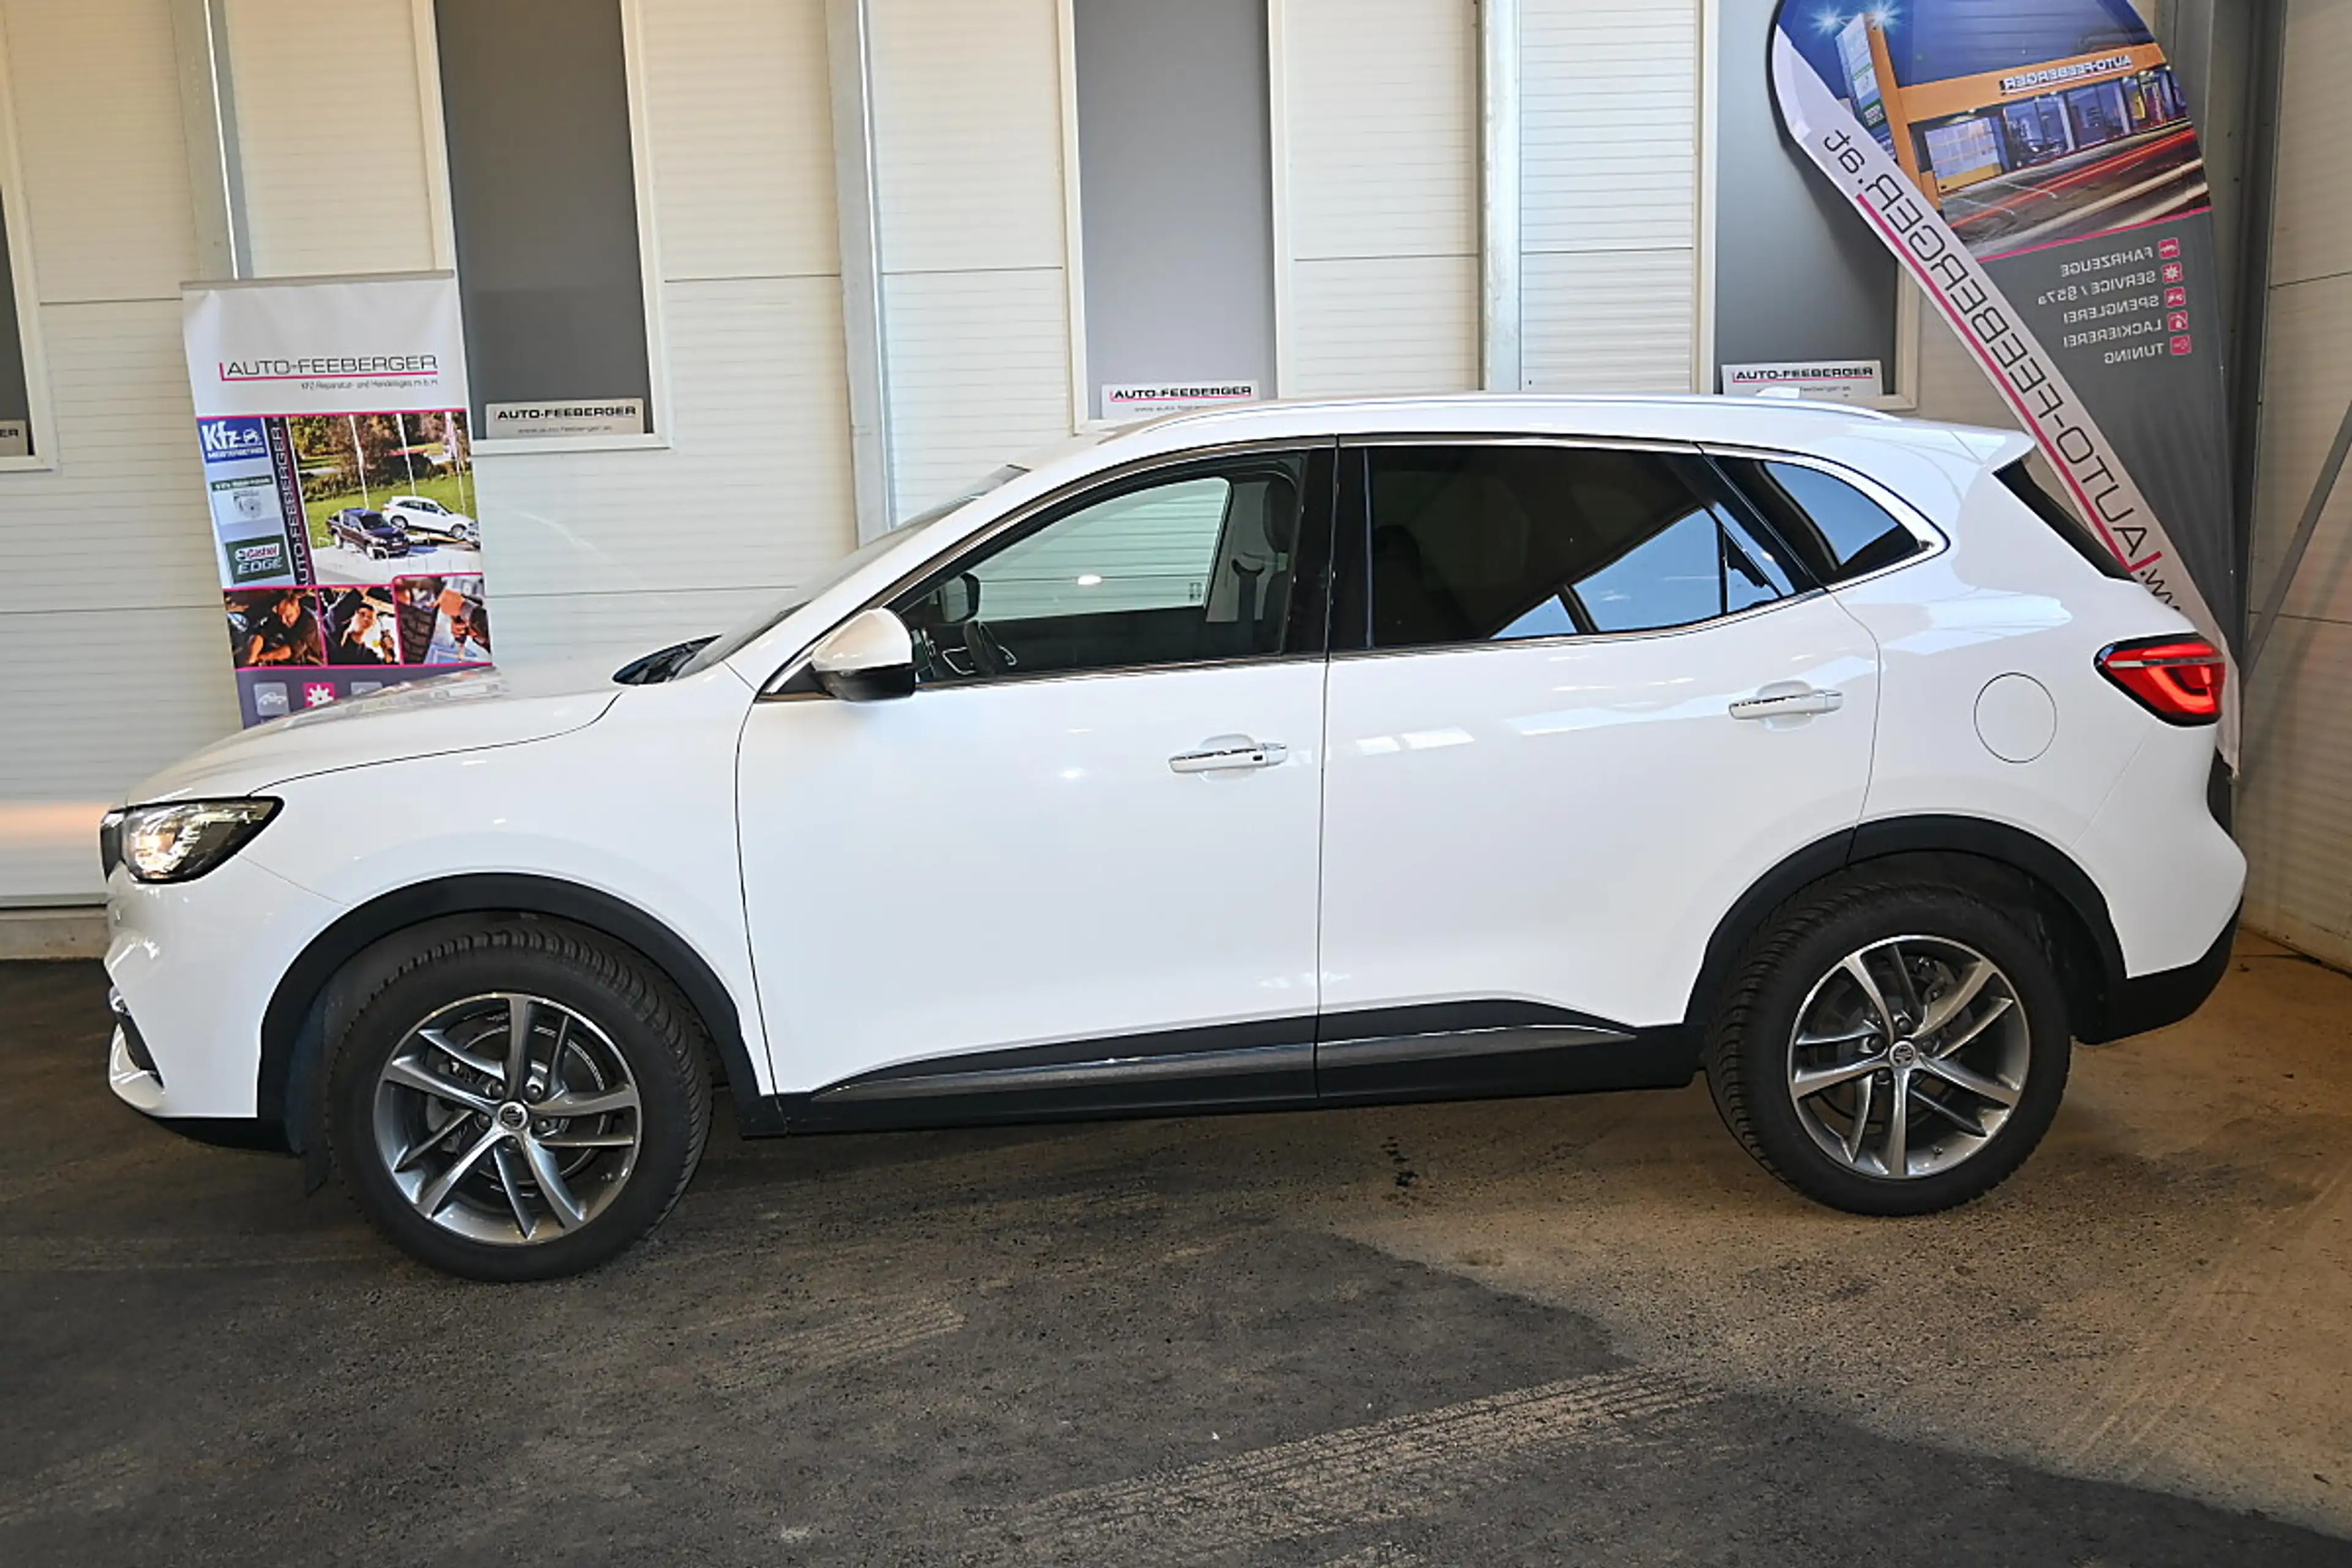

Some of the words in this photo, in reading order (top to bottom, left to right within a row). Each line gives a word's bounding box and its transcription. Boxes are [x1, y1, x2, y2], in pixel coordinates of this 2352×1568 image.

[227, 355, 438, 375] AUTO-FEEBERGER
[1736, 367, 1873, 380] AUTO-FEEBERGER
[1115, 386, 1251, 399] AUTO-FEEBERGER
[498, 405, 636, 420] AUTO-FEEBERGER
[238, 557, 282, 575] EDGE
